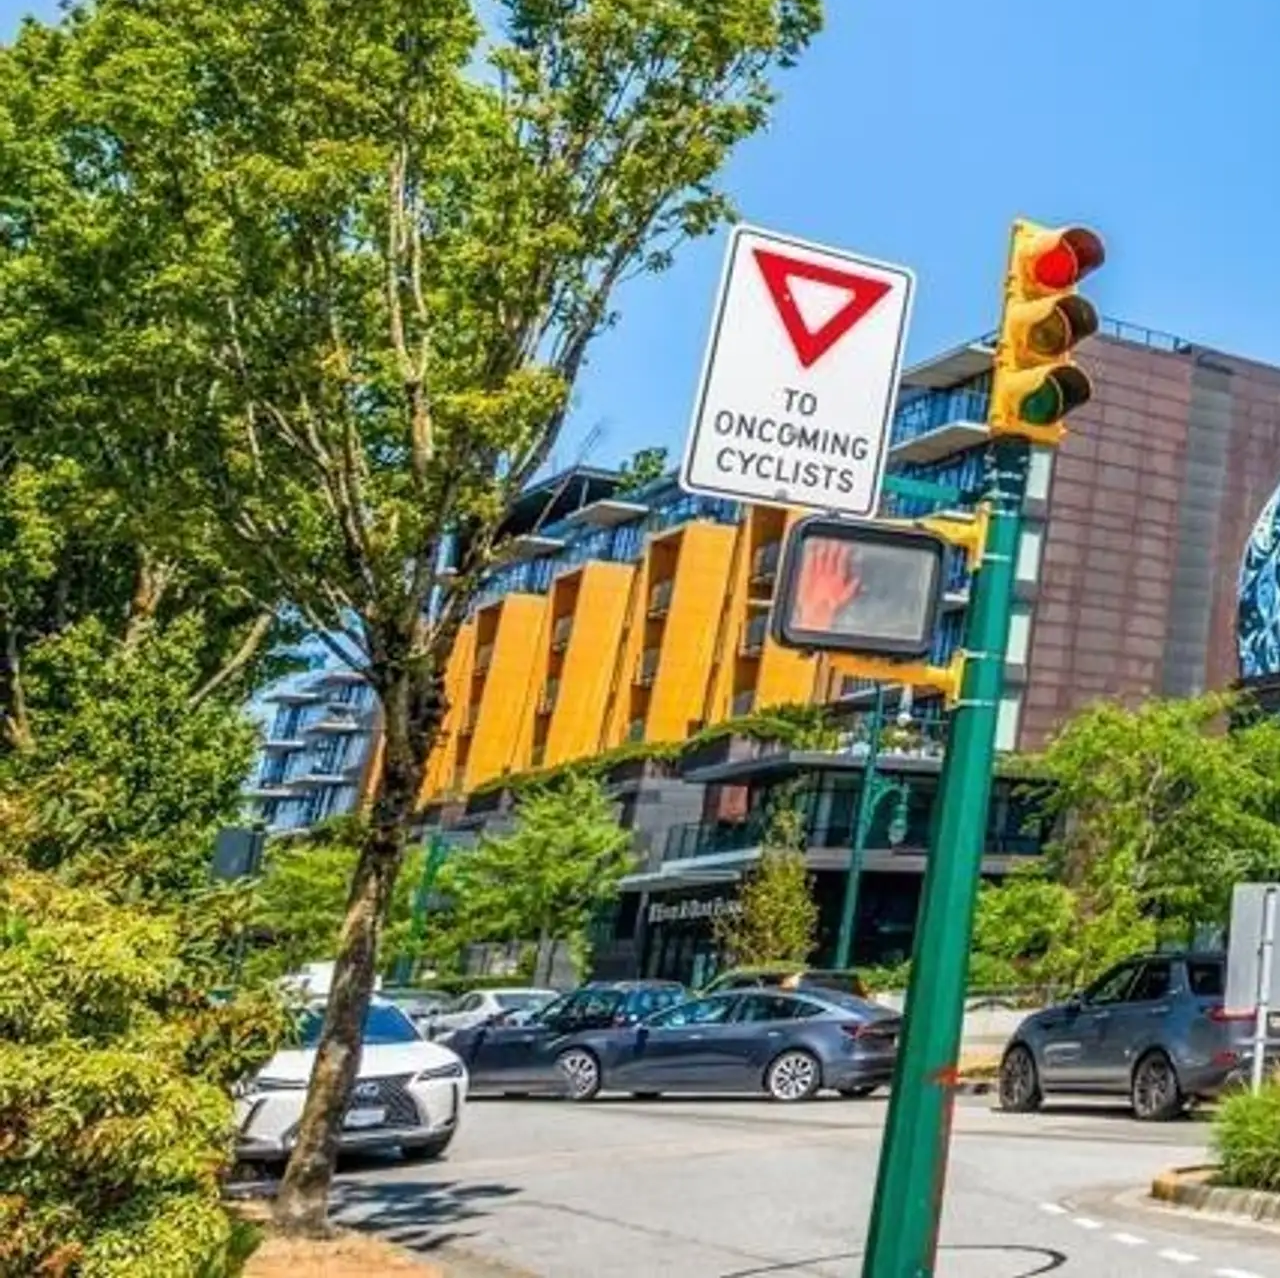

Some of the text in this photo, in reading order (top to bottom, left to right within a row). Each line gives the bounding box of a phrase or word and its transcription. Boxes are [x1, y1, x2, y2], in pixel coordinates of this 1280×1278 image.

[784, 387, 818, 416] TO
[714, 410, 868, 460] ONCOMING
[716, 446, 854, 493] CYCLISTS
